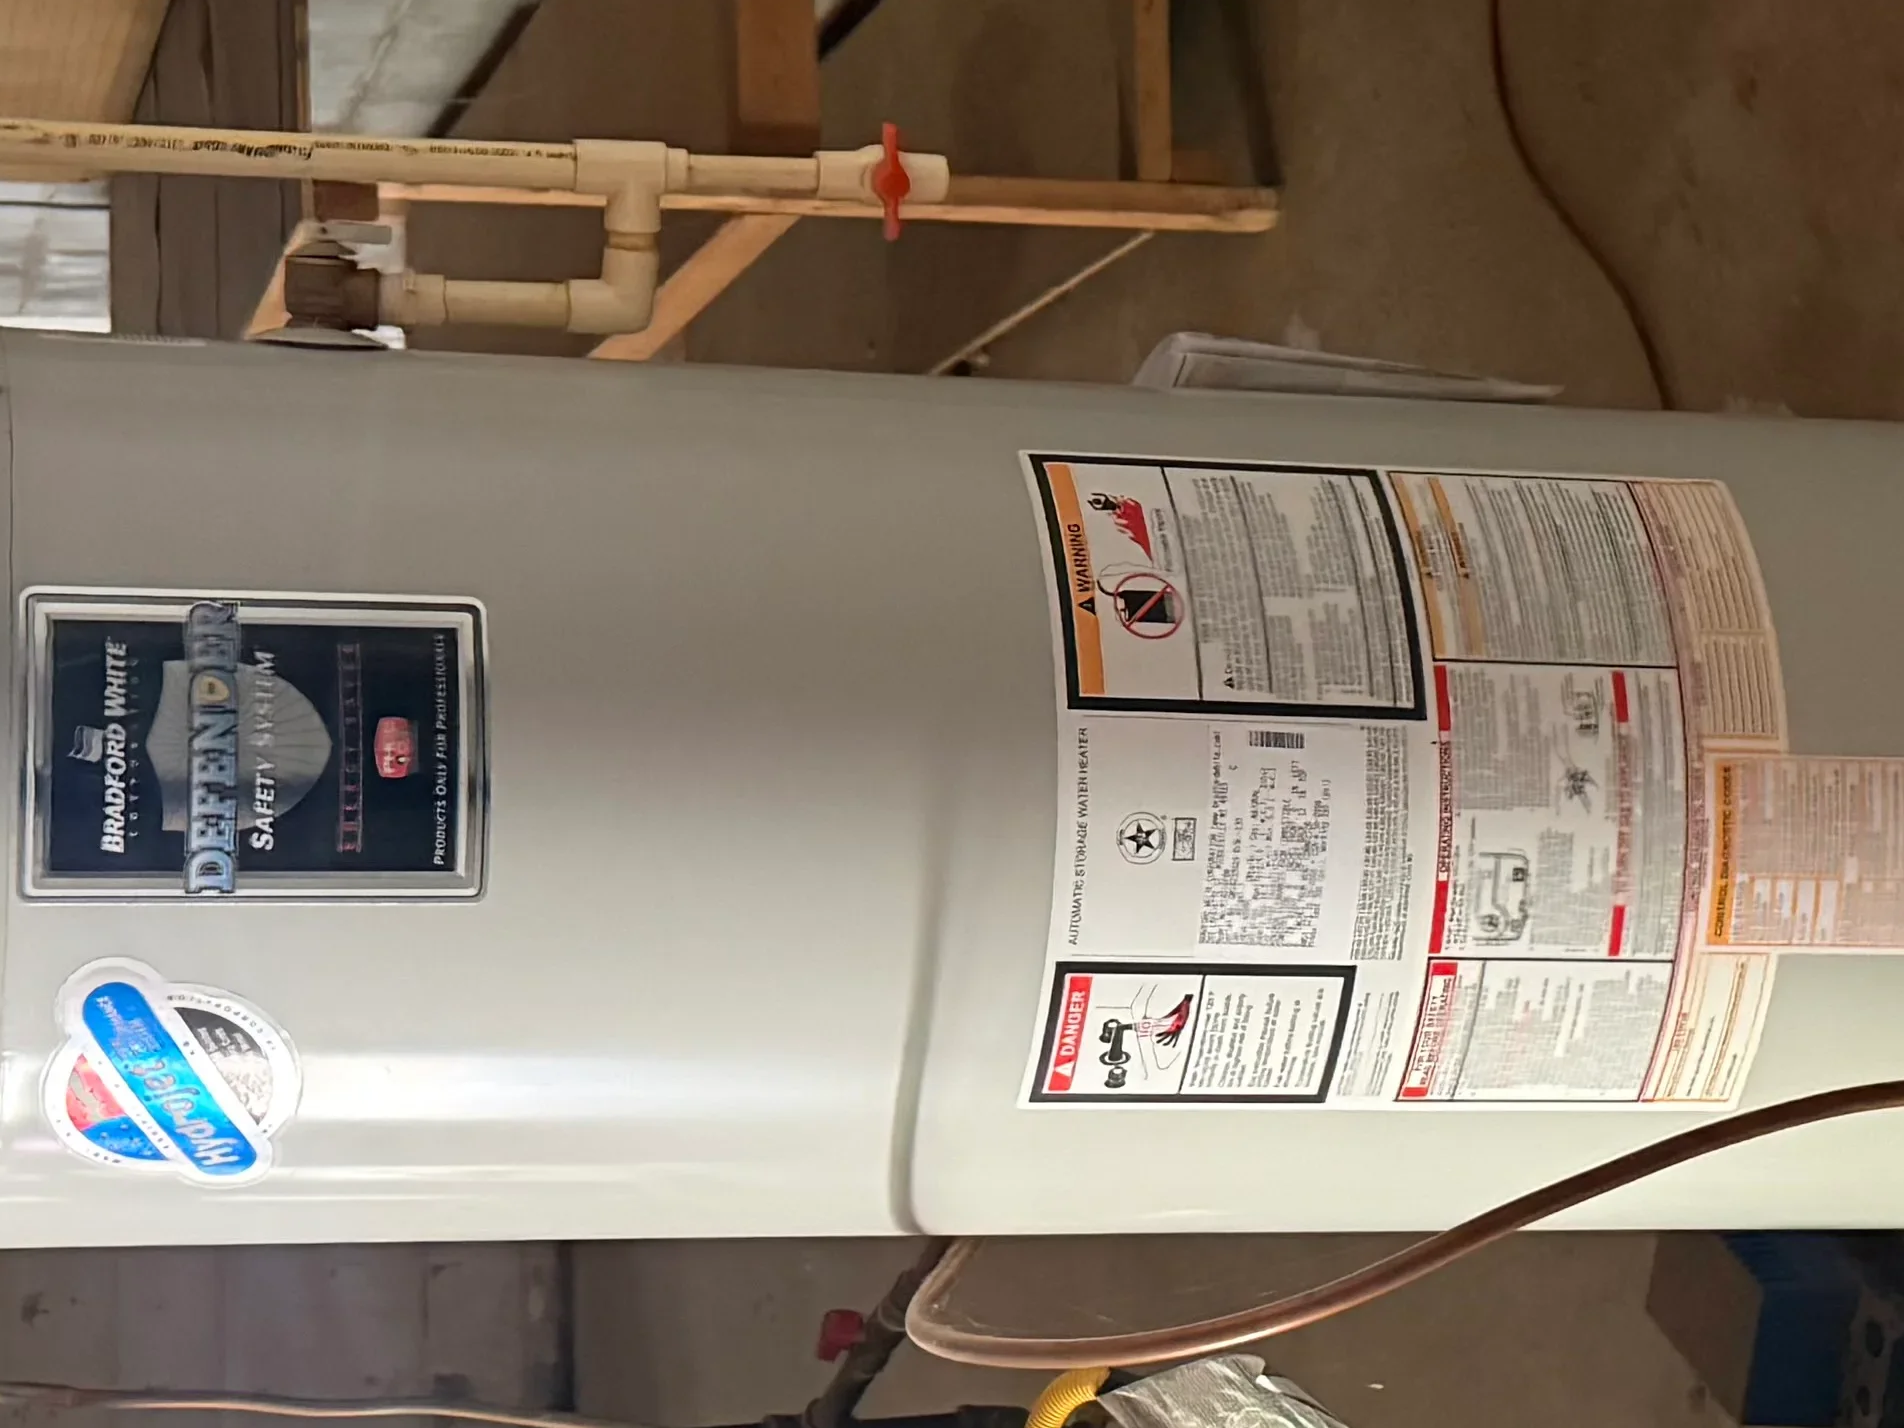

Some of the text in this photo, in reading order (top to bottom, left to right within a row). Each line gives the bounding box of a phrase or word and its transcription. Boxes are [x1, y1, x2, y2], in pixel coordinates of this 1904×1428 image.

[1066, 523, 1092, 593] WARNING
[100, 640, 128, 853] BRADFORD WHITE
[185, 599, 242, 896] DEFENDER
[1077, 726, 1089, 774] HEATER
[249, 757, 276, 851] SAFETY
[1076, 776, 1089, 818] WATER
[433, 799, 447, 865] PRODUCTS
[1068, 879, 1086, 946] AUTOMATIC
[1059, 991, 1086, 1055] DANGER
[124, 1057, 241, 1166] Hydrojet
